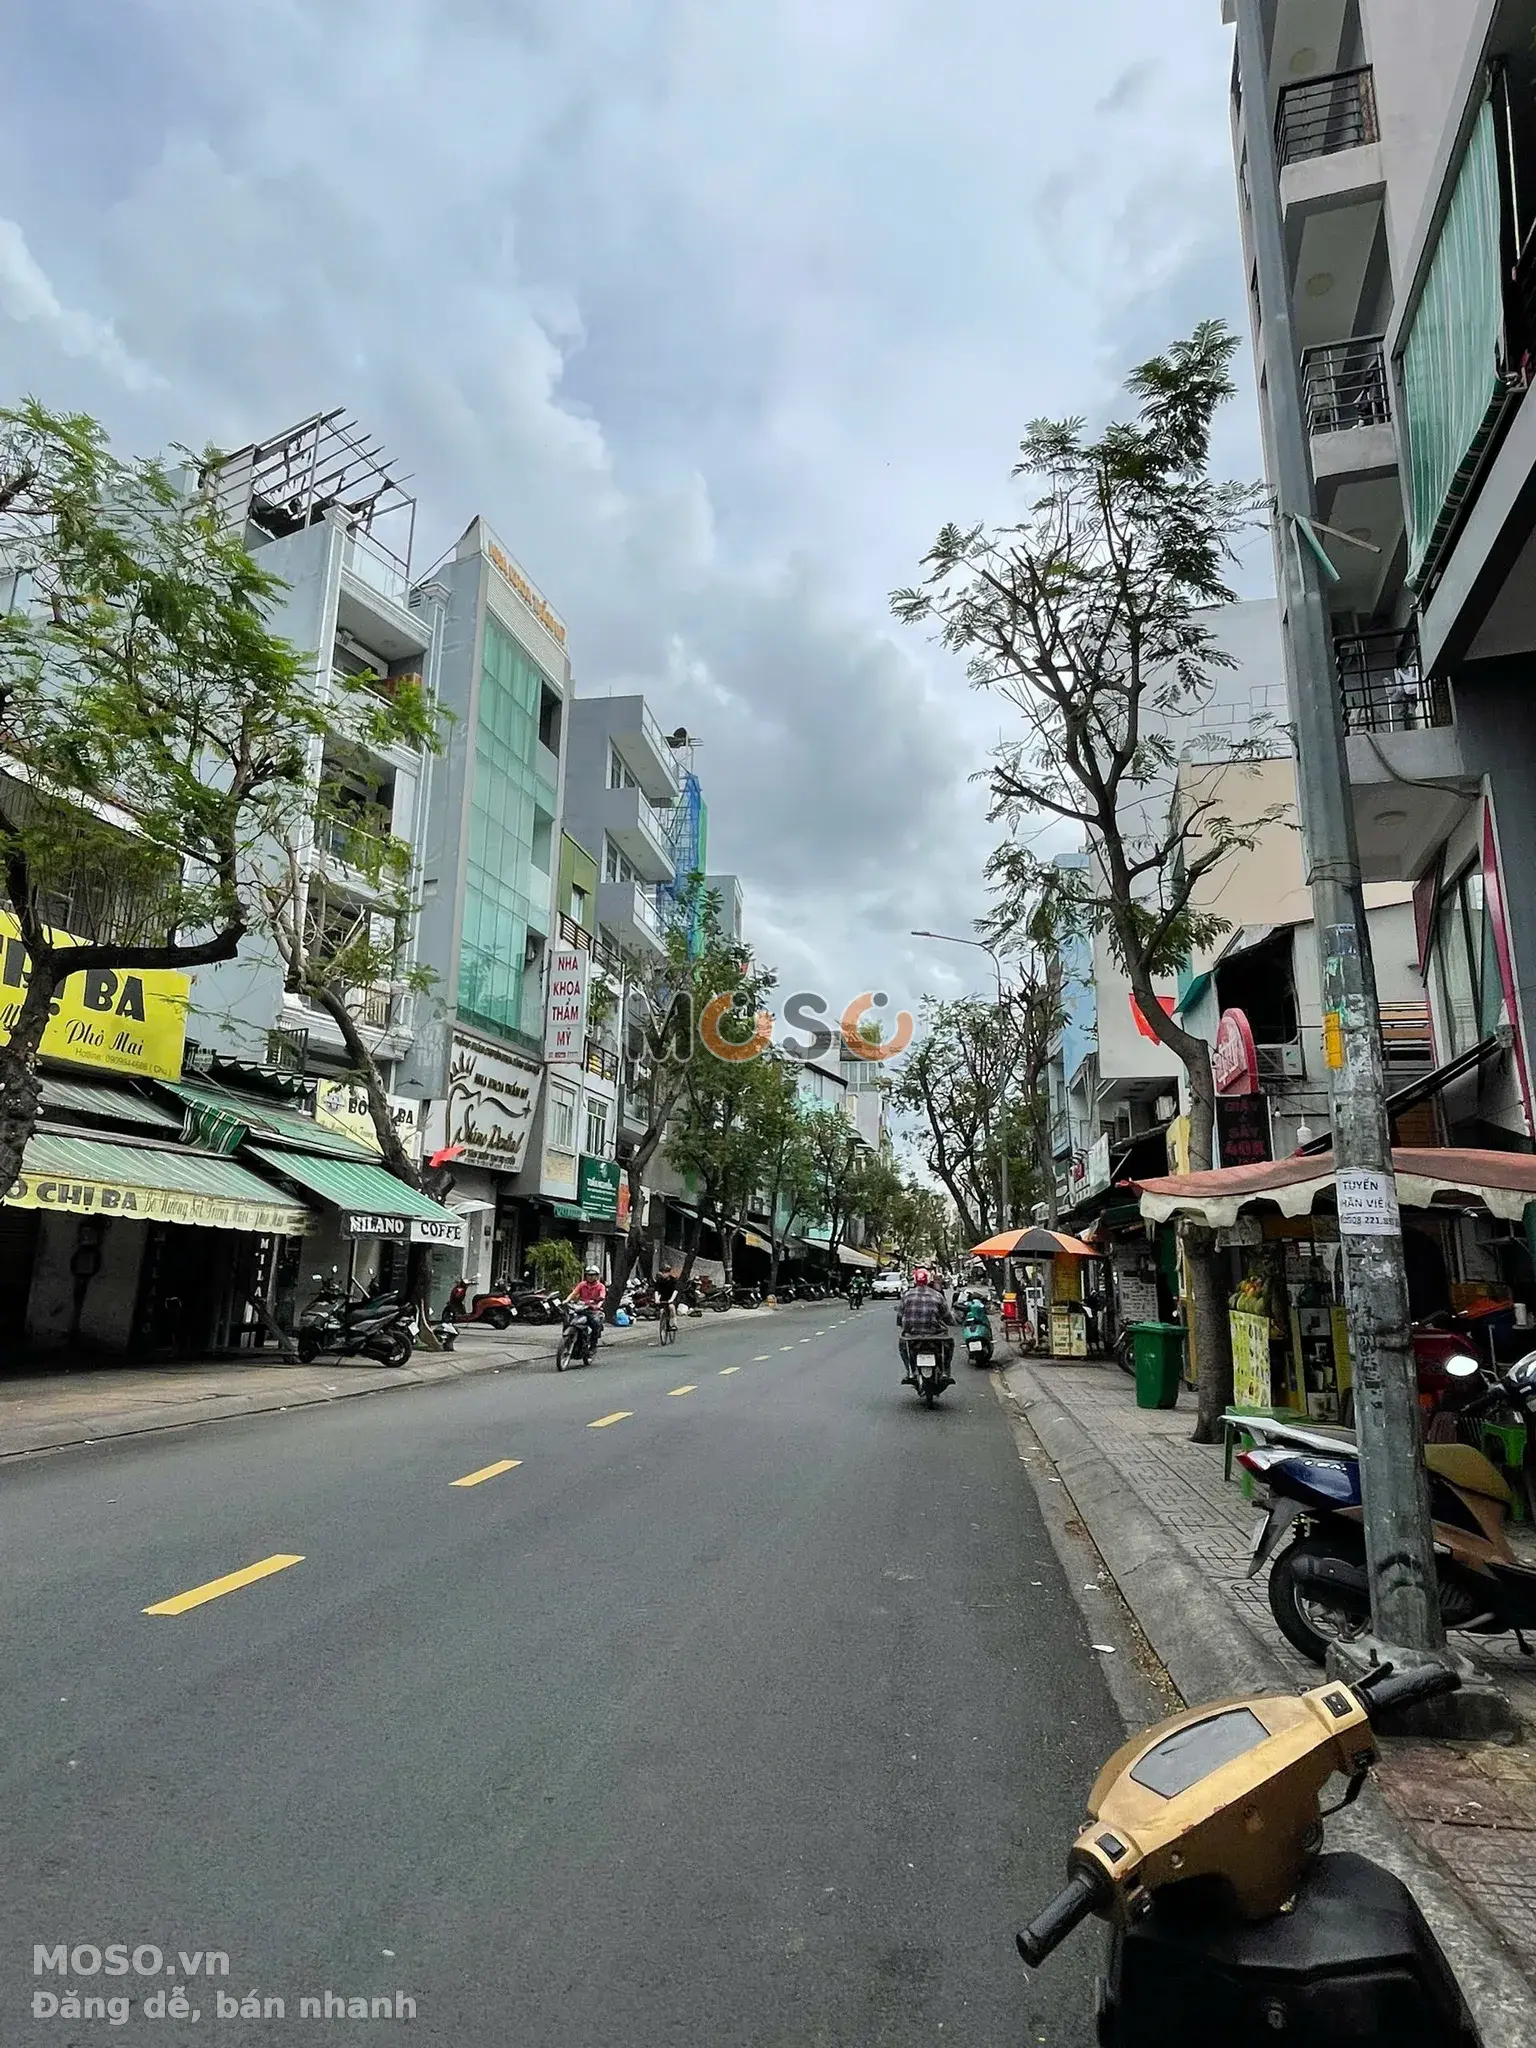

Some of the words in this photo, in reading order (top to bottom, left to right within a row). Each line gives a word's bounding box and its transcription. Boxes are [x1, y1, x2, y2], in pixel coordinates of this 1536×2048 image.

[557, 956, 579, 971] NHA
[83, 968, 146, 1022] BA
[552, 980, 581, 996] KHOA
[552, 998, 579, 1021] THẨM
[108, 1031, 144, 1056] Mai
[398, 1107, 414, 1125] BA
[37, 1182, 95, 1211] CHỊ
[101, 1188, 137, 1211] BA
[349, 1216, 405, 1234] MILANO
[420, 1221, 462, 1240] COFFE
